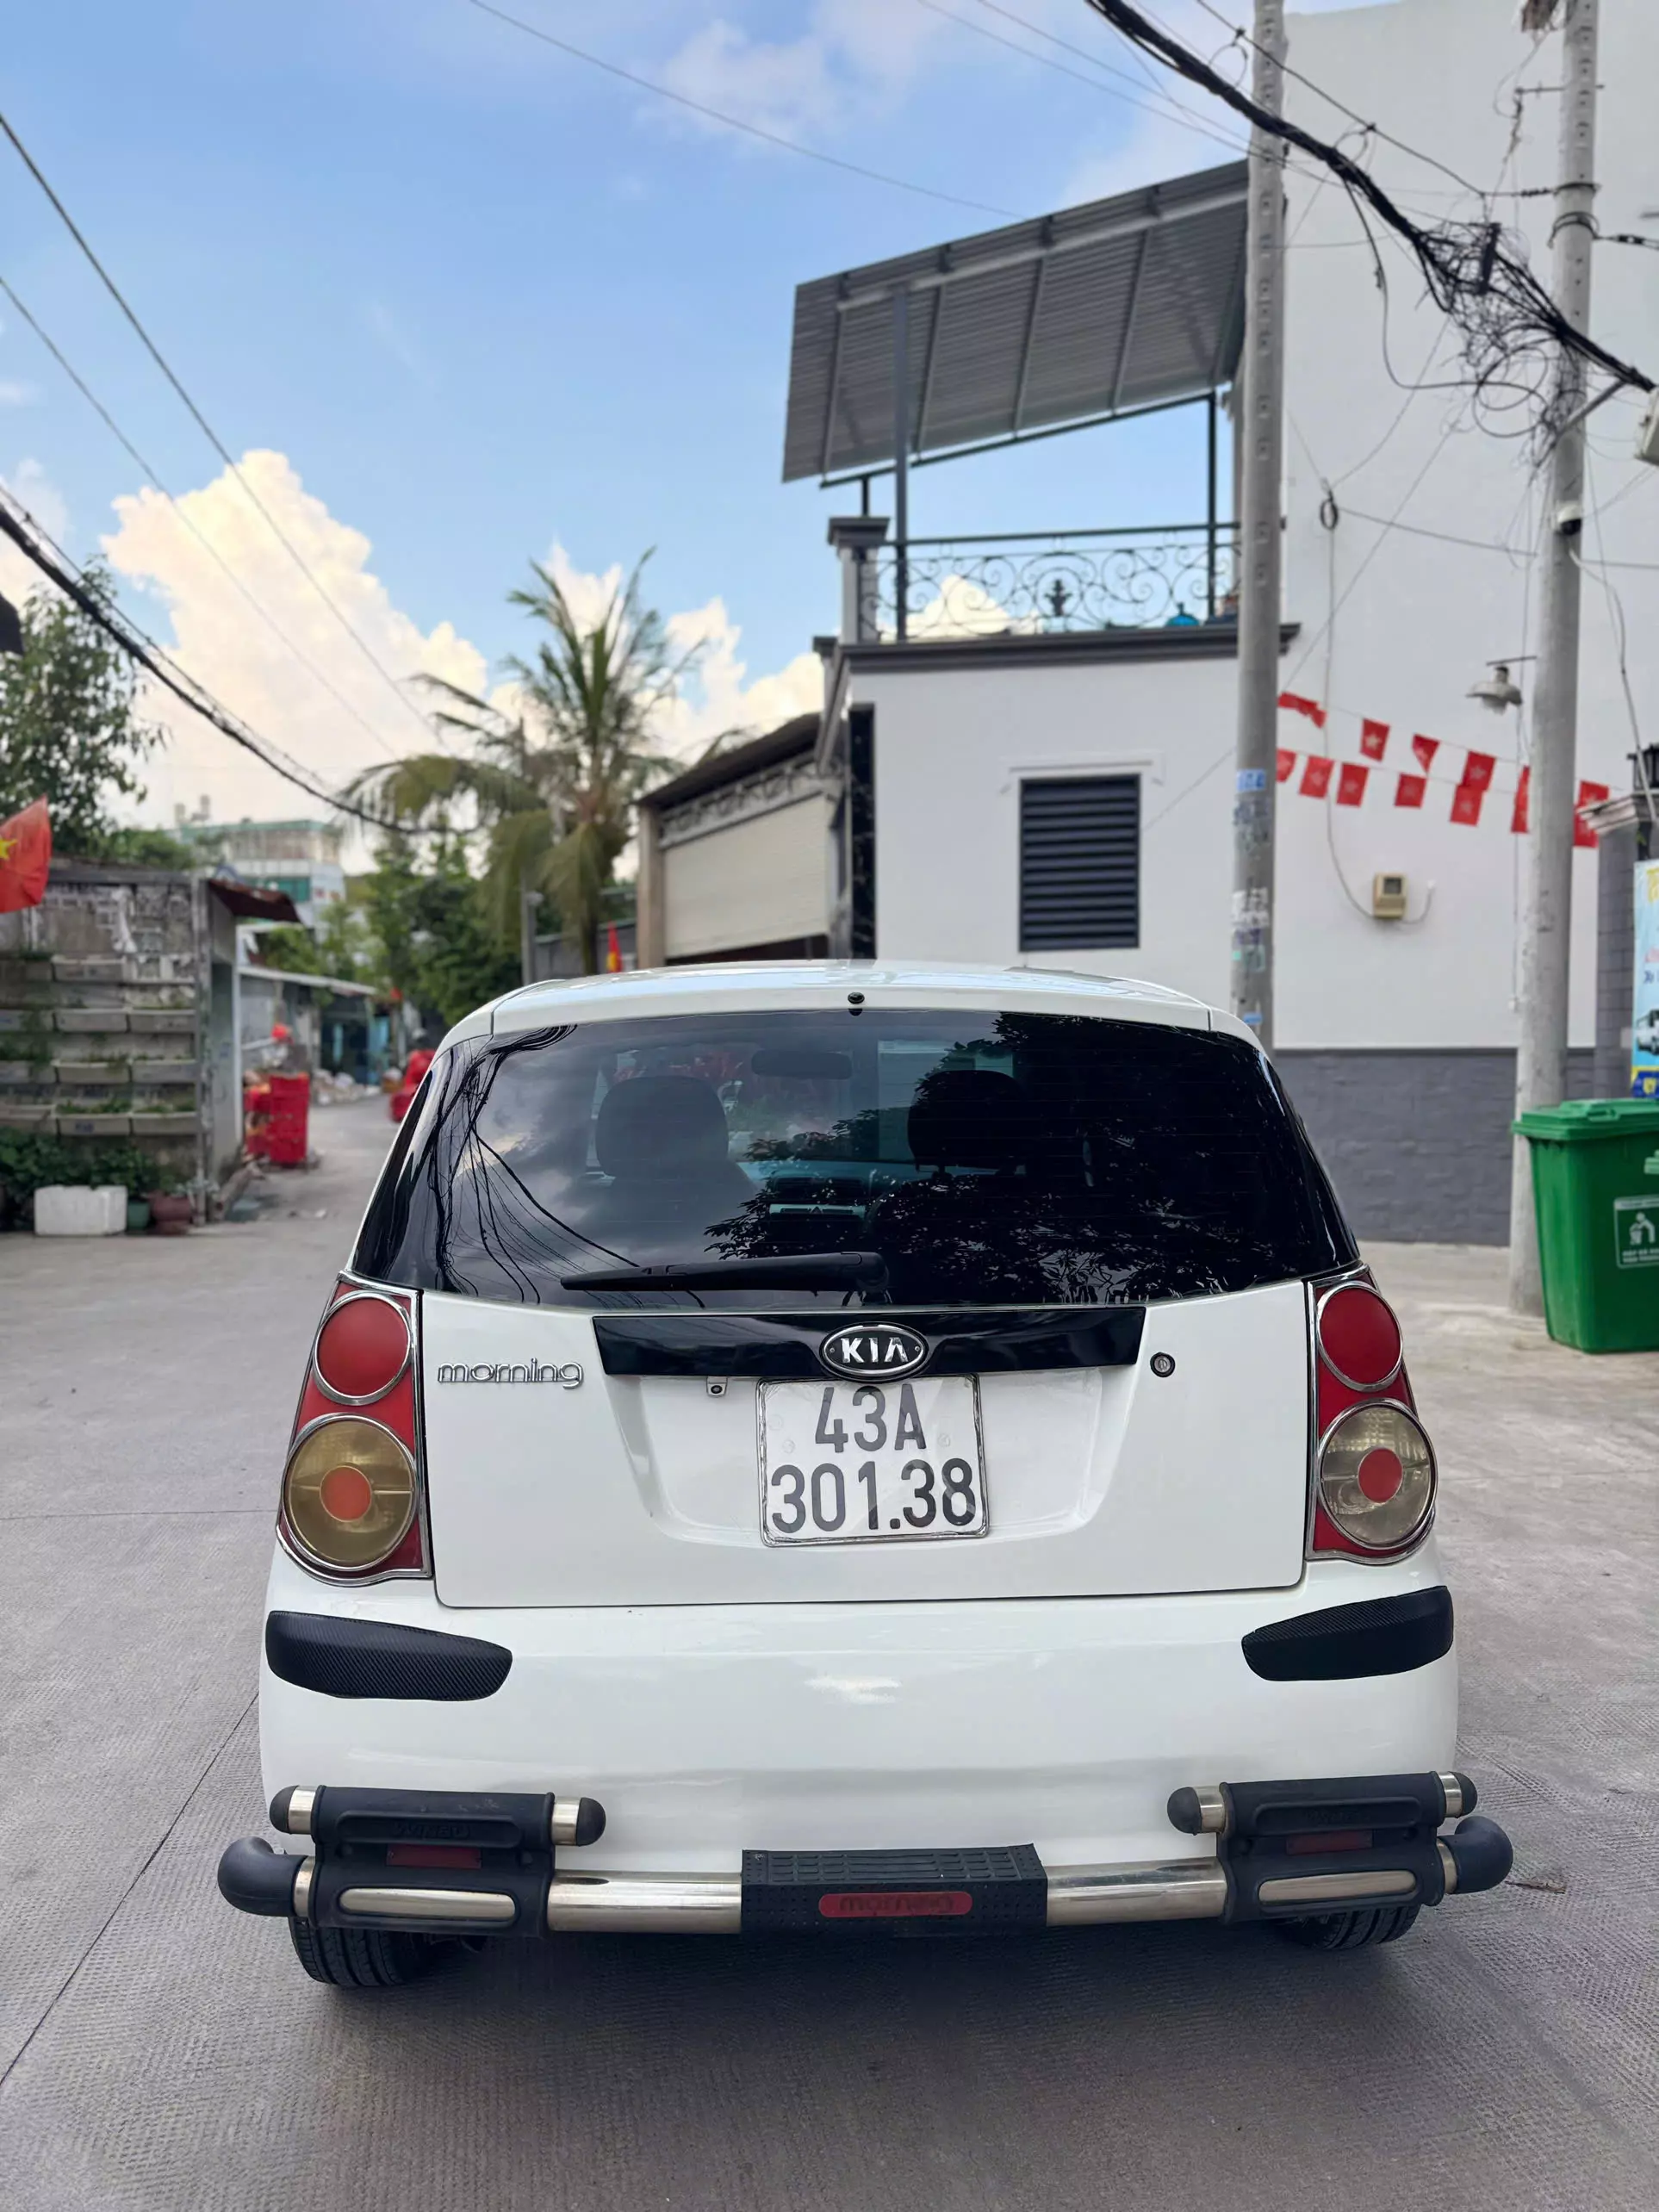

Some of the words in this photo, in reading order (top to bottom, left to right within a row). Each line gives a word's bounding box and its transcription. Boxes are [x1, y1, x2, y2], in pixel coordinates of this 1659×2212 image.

[438, 1358, 584, 1389] morning
[840, 1337, 909, 1364] KIA
[815, 1383, 927, 1453] 43A
[771, 1457, 976, 1534] 301.38
